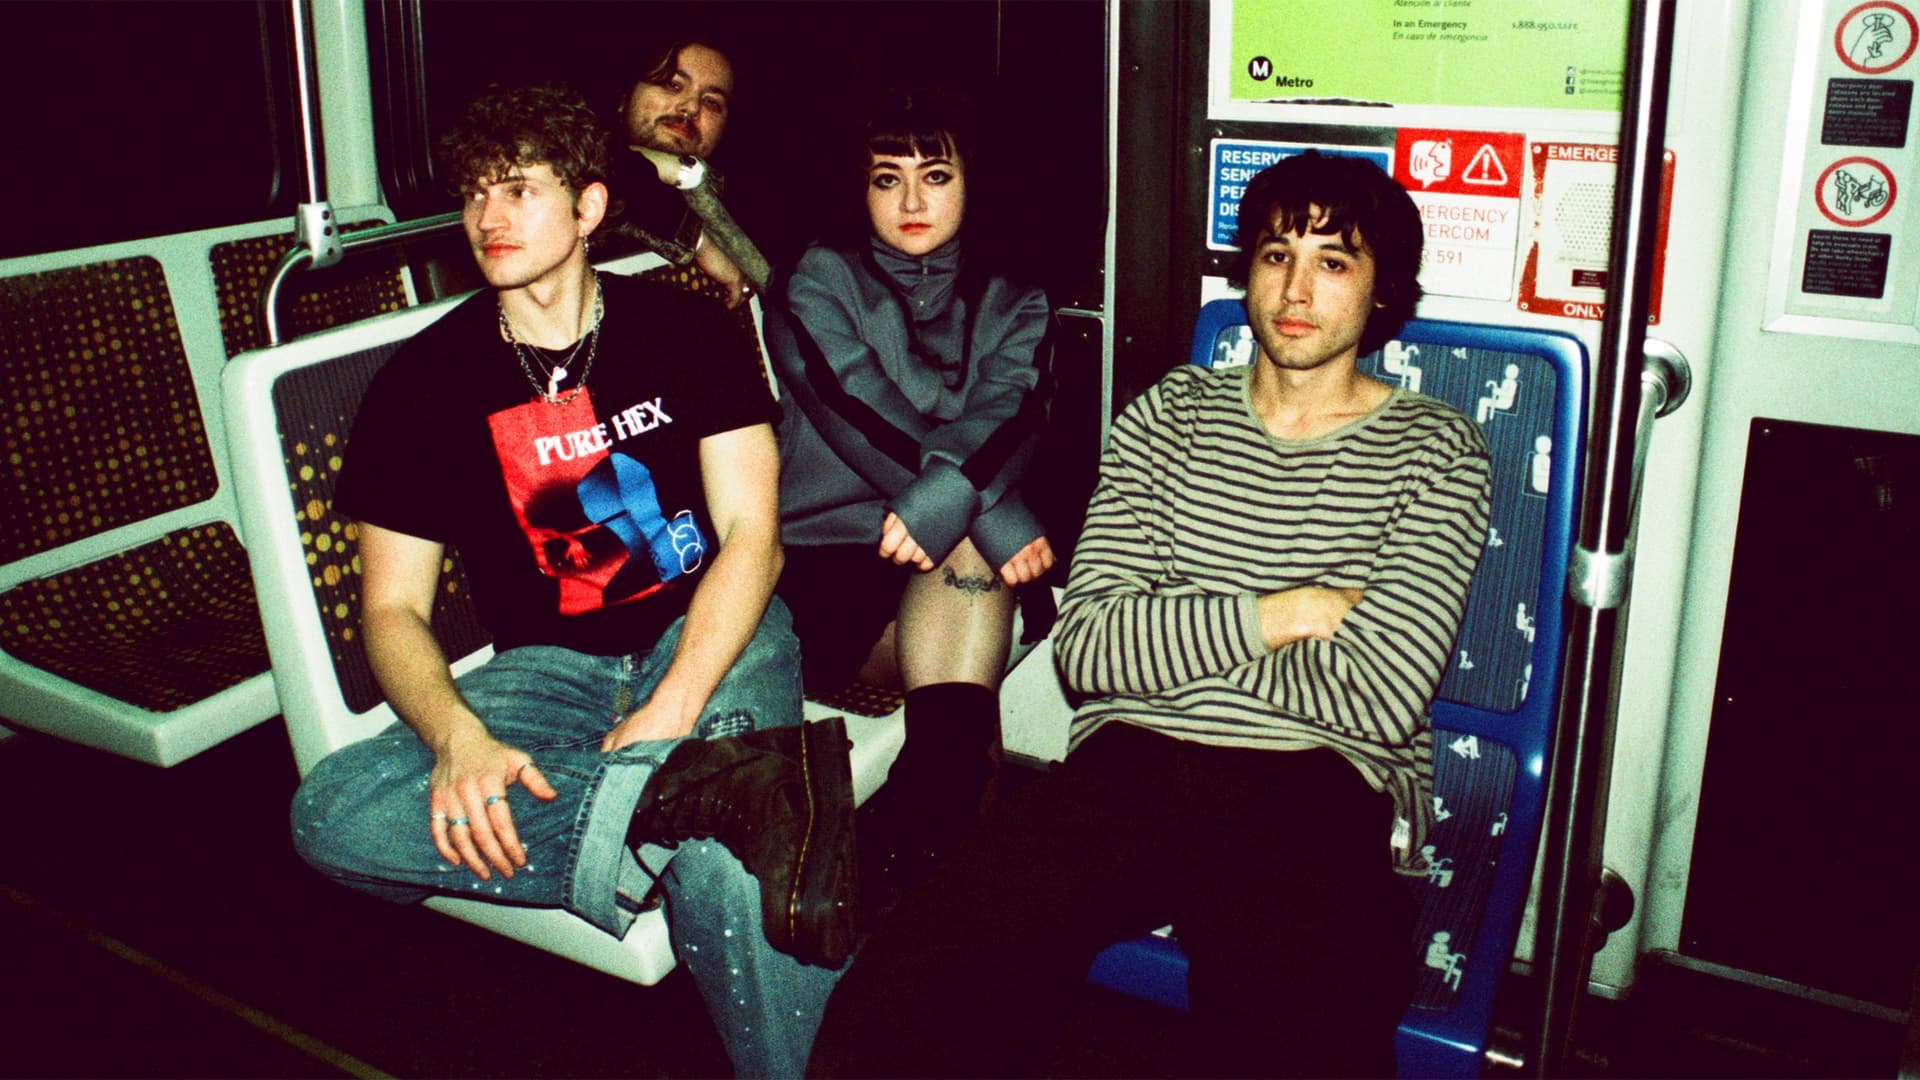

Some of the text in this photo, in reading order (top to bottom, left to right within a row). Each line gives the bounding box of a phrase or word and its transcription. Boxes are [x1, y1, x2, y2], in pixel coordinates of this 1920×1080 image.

[1393, 19, 1402, 28] In
[1418, 19, 1467, 30] Emergency
[1275, 75, 1314, 88] Metro
[1221, 150, 1297, 167] RESERV
[1548, 145, 1618, 162] EMERGE
[1419, 204, 1508, 223] ERGENCY
[1436, 250, 1462, 264] 591
[1563, 303, 1605, 319] ONLY
[534, 397, 673, 466] PURE HEX
